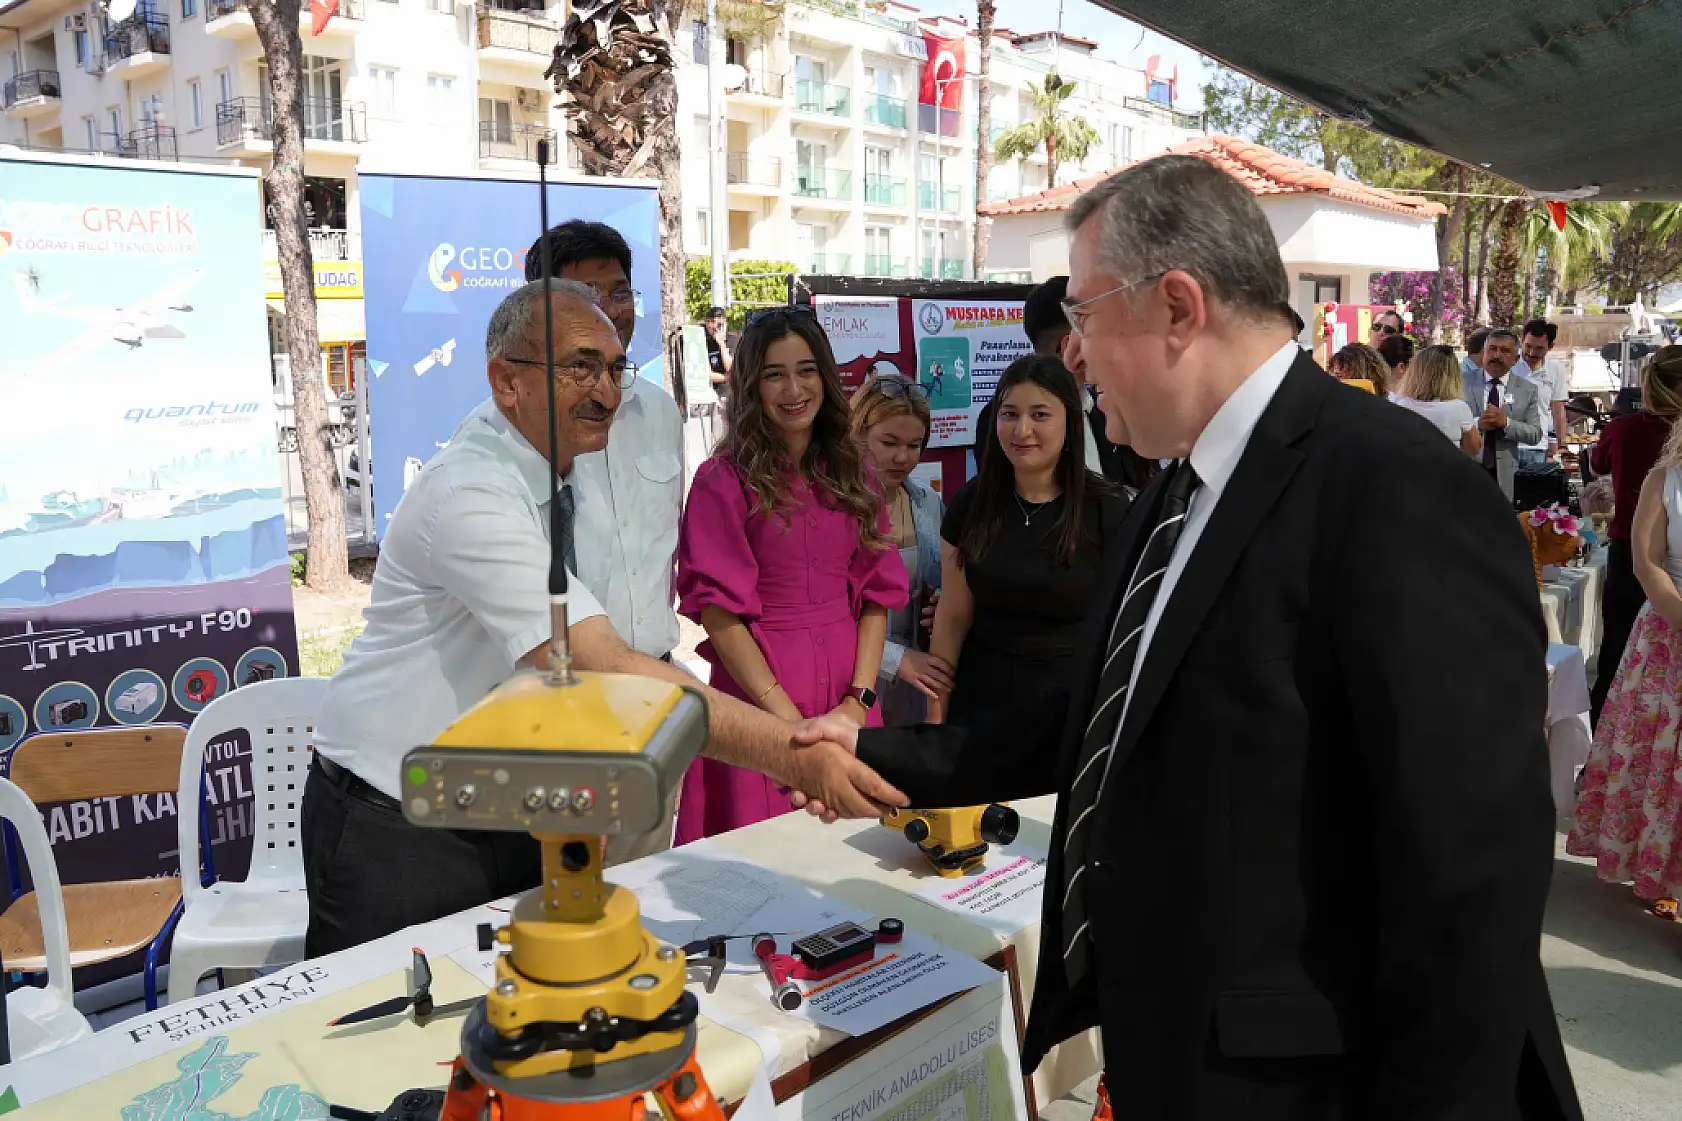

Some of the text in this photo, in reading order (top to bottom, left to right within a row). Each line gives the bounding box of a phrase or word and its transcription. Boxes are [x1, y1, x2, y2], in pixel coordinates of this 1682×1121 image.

[82, 205, 193, 235] GRAFİK
[824, 316, 868, 332] EMLAK
[945, 307, 1005, 320] MUSTAFA
[124, 400, 260, 424] quantum
[40, 621, 194, 660] TRINITY
[42, 795, 122, 846] ABİT
[831, 1016, 1000, 1121] TEKNİK ANADOLU LİSESİ
